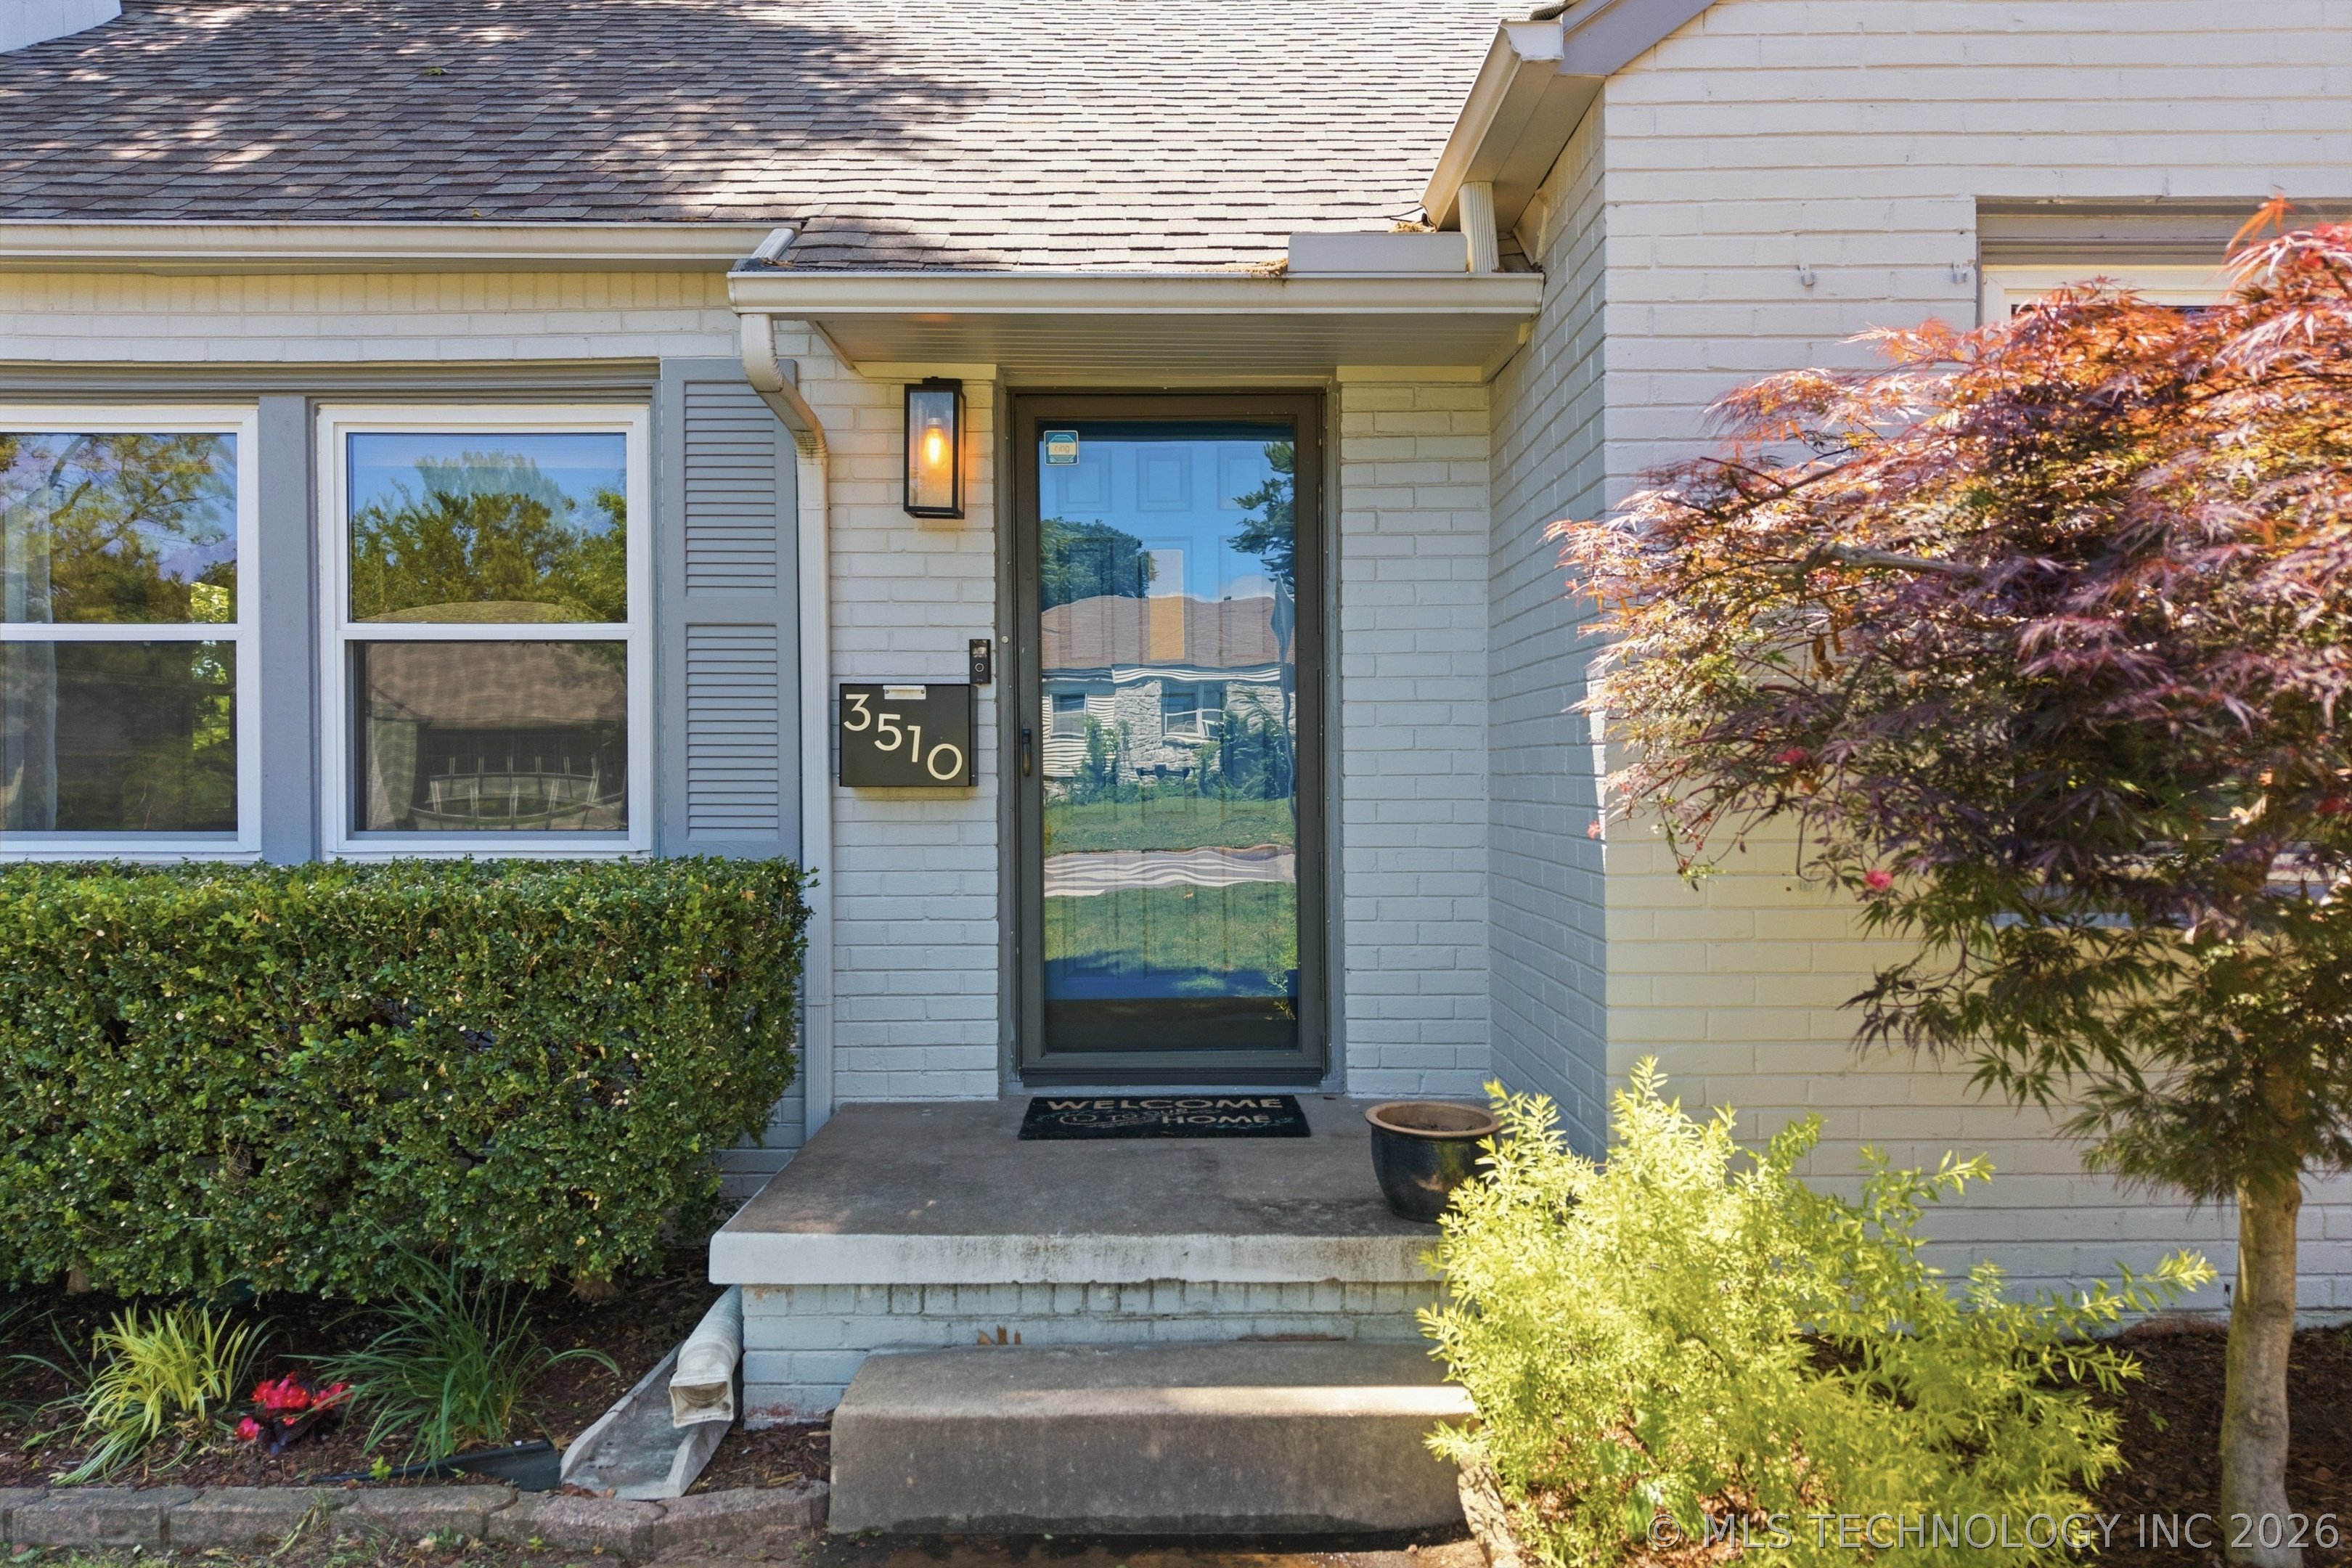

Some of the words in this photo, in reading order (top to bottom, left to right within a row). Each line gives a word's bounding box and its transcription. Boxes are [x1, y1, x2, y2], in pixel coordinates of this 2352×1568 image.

[843, 693, 963, 780] 3510
[1047, 1098, 1283, 1110] WELCOME
[1161, 1115, 1271, 1124] HOME
